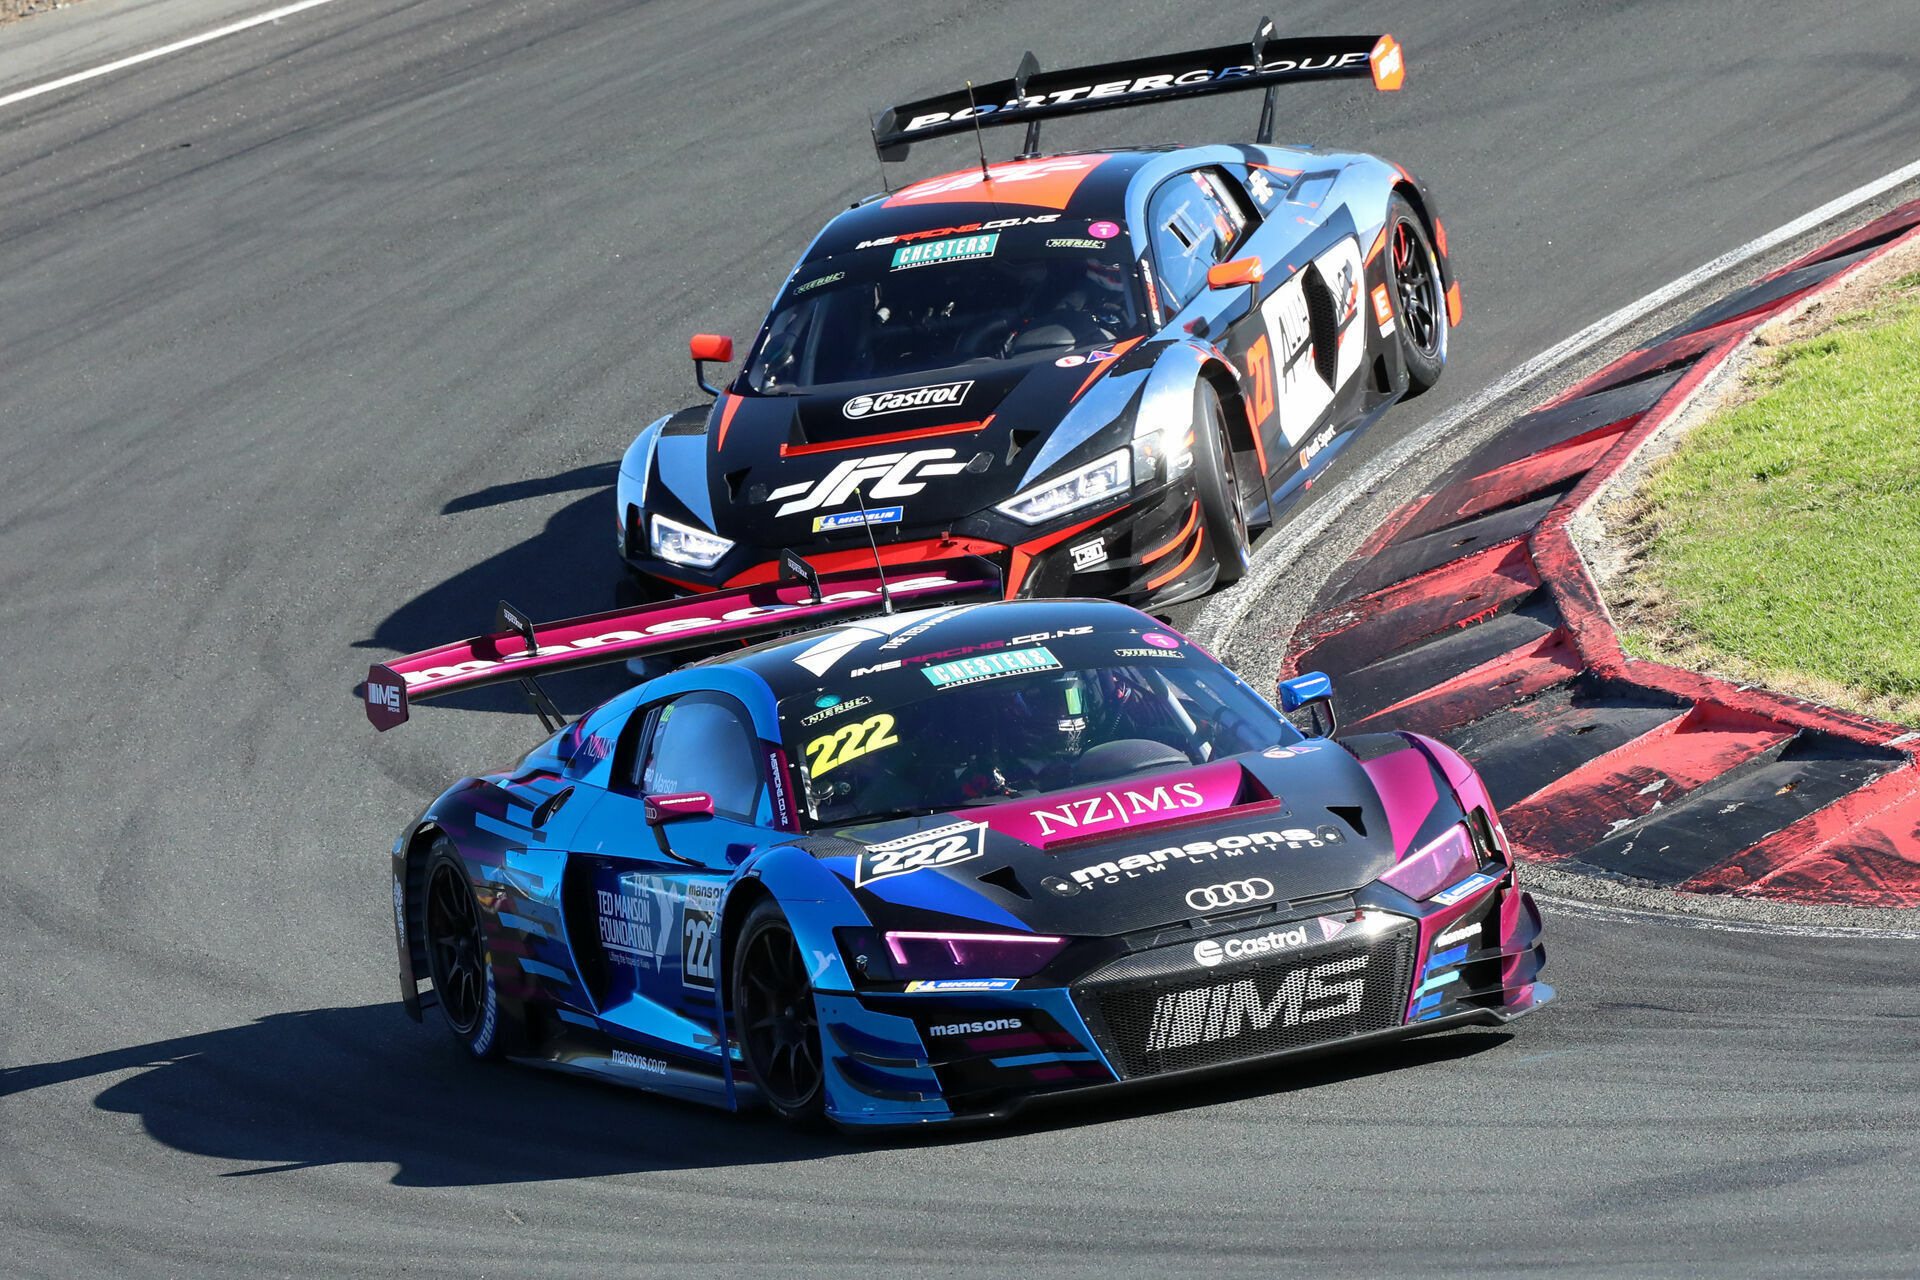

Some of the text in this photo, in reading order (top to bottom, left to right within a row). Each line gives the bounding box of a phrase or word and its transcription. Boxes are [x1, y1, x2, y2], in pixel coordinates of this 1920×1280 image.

[855, 213, 1061, 250] IMSRACING.CO.NZ
[900, 235, 990, 263] CHESTERS
[1375, 289, 1389, 318] E
[873, 383, 957, 412] Castrol
[766, 448, 968, 518] JFC
[837, 512, 895, 525] MICHELIN
[404, 576, 957, 687] mansons
[850, 626, 1094, 678] IMSRACING.CO.NZ
[932, 649, 1047, 681] CHESTERS
[806, 713, 898, 779] 222
[868, 820, 974, 849] mansons
[869, 835, 972, 875] 222
[1070, 828, 1317, 884] mansons
[1081, 840, 1325, 890] TCLM LIMITED
[633, 872, 650, 898] THE
[597, 890, 650, 924] TED MANSON
[599, 917, 654, 951] FOUNDATION
[685, 918, 715, 979] 22
[1225, 926, 1308, 958] Castrol
[473, 986, 497, 1054] MICHELIN
[929, 1018, 1022, 1037] mansons
[612, 1049, 667, 1075] mansons.co.nz
